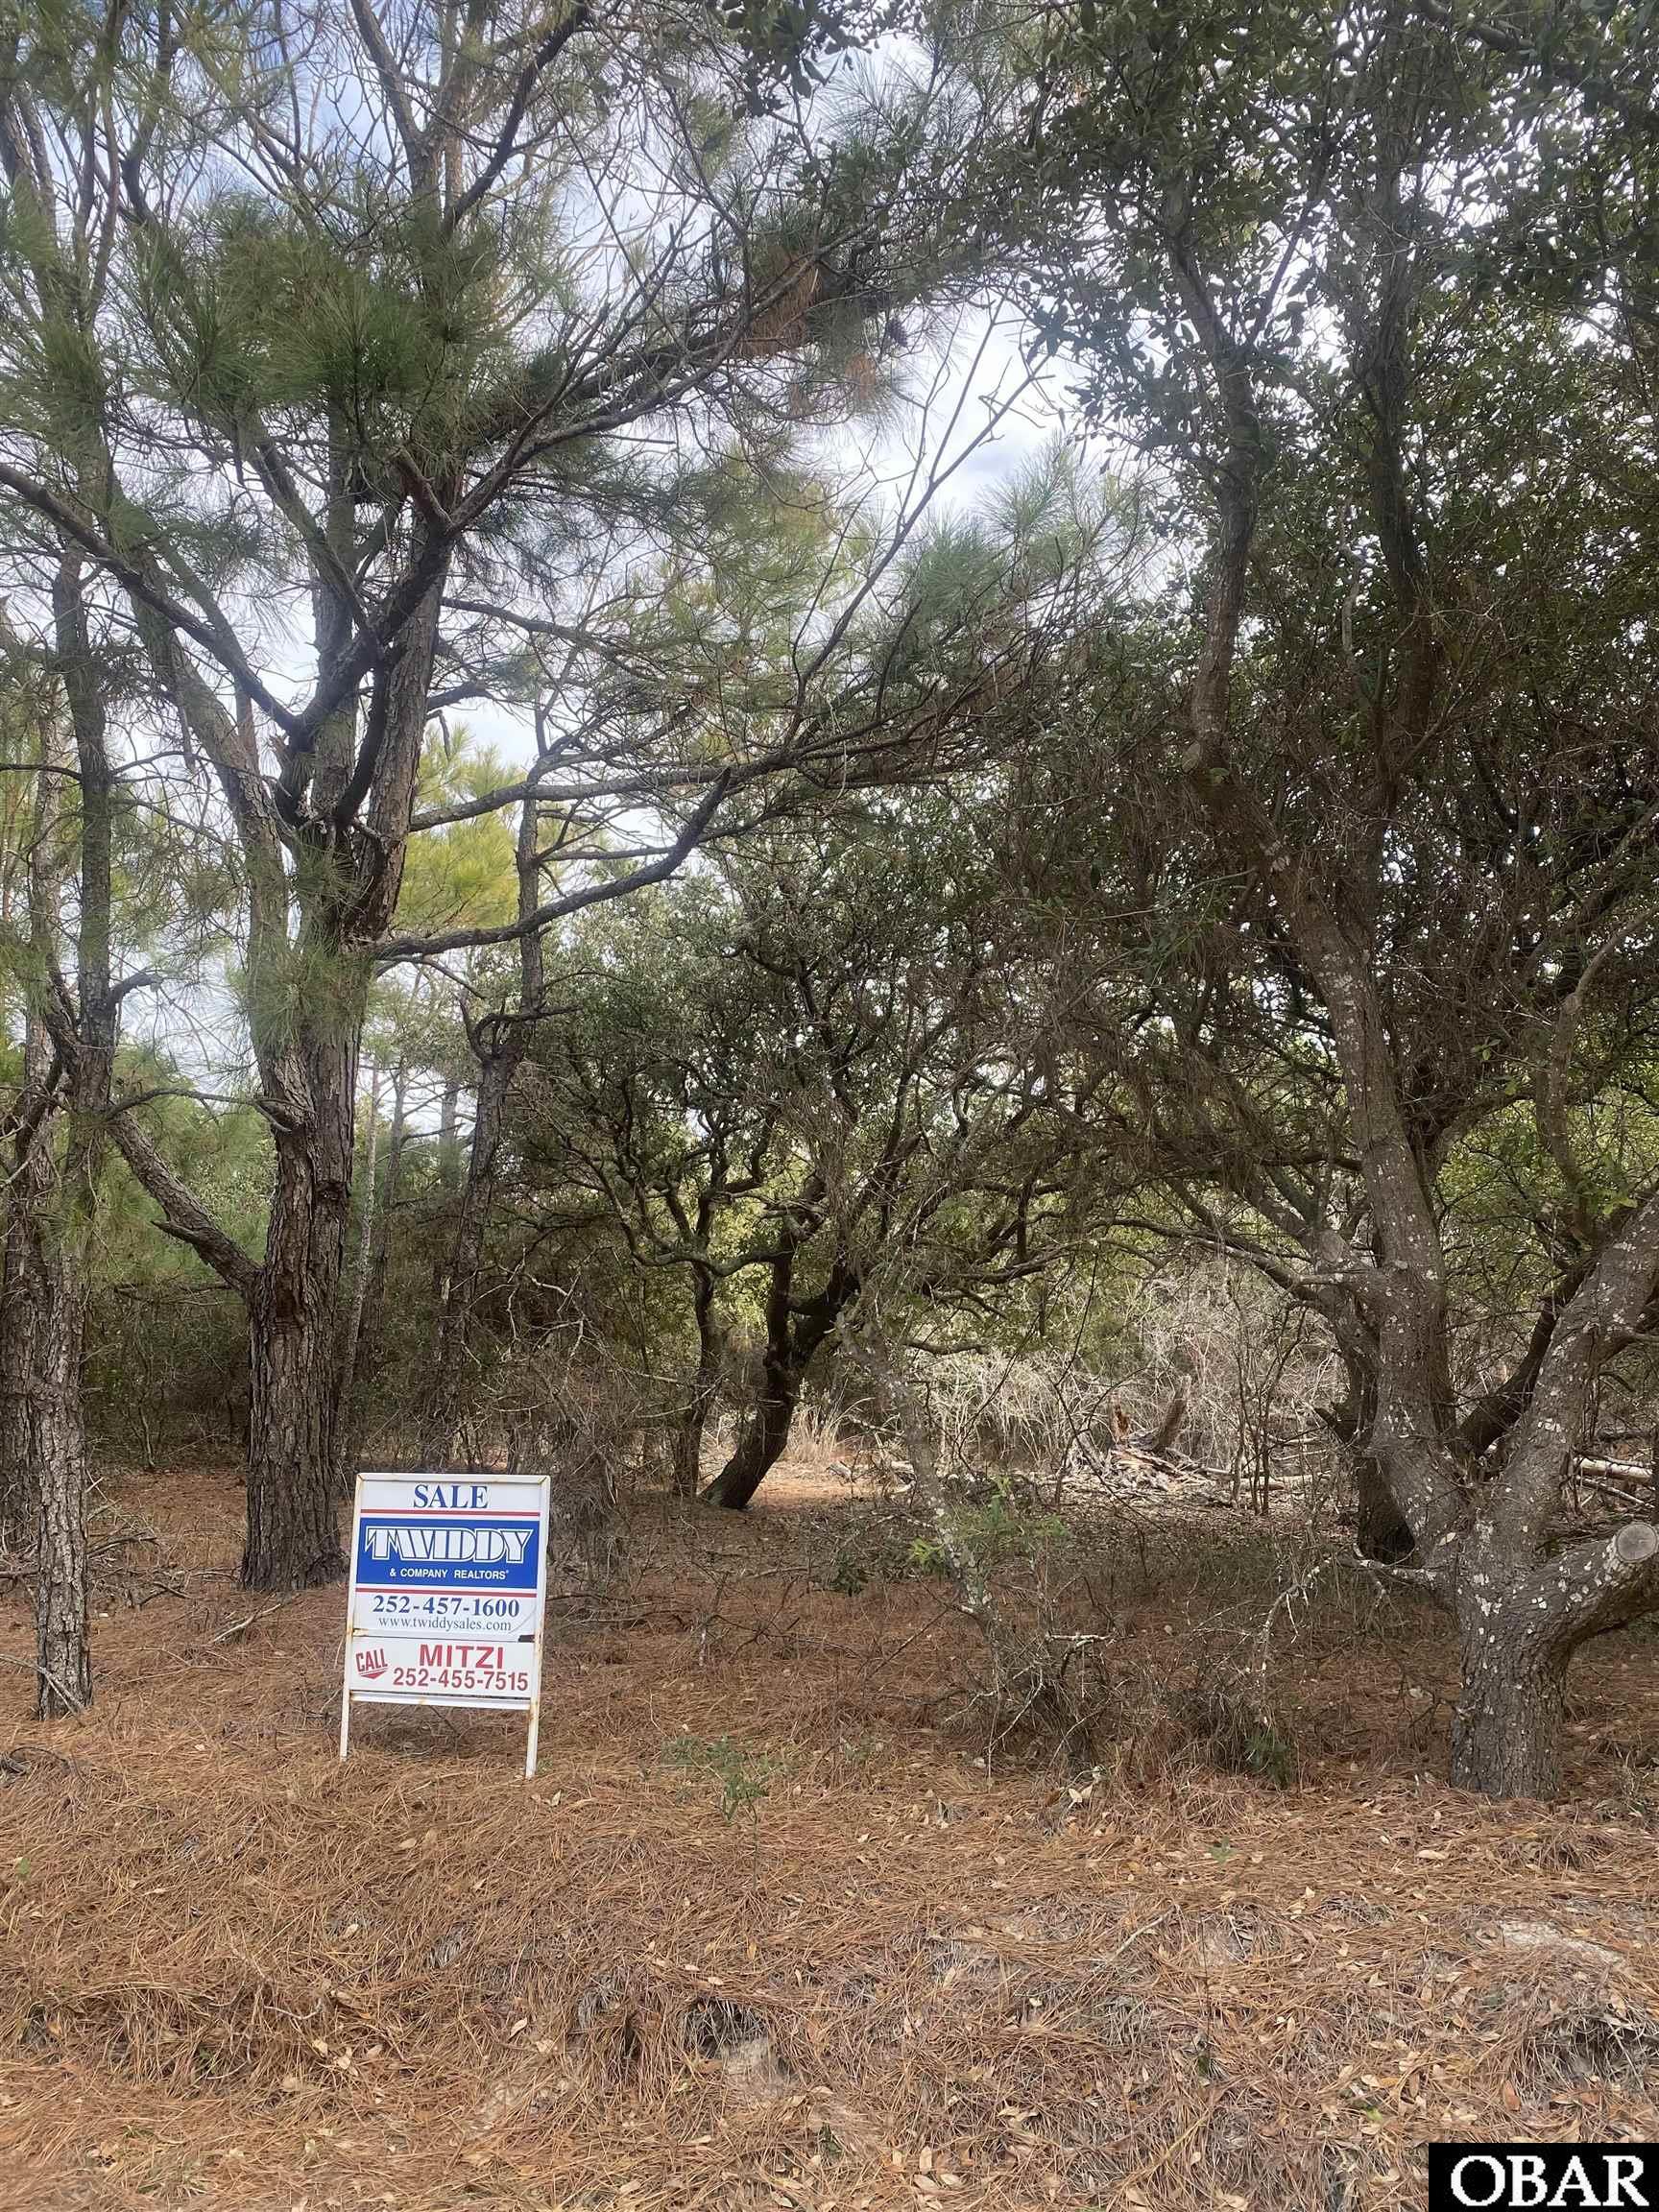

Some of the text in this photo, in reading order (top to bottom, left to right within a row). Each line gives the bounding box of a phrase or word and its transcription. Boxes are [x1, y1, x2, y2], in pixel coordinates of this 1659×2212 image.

[414, 1484, 488, 1508] SALE
[365, 1526, 533, 1563] TWIDDY
[389, 1568, 397, 1576] &
[400, 1569, 447, 1578] COMPANY
[373, 1595, 519, 1617] 252-457-1600
[378, 1616, 512, 1631] www.twiddysales.com
[355, 1648, 388, 1672] CALL
[419, 1644, 504, 1669] MITZI
[393, 1668, 528, 1691] 252-455-7515
